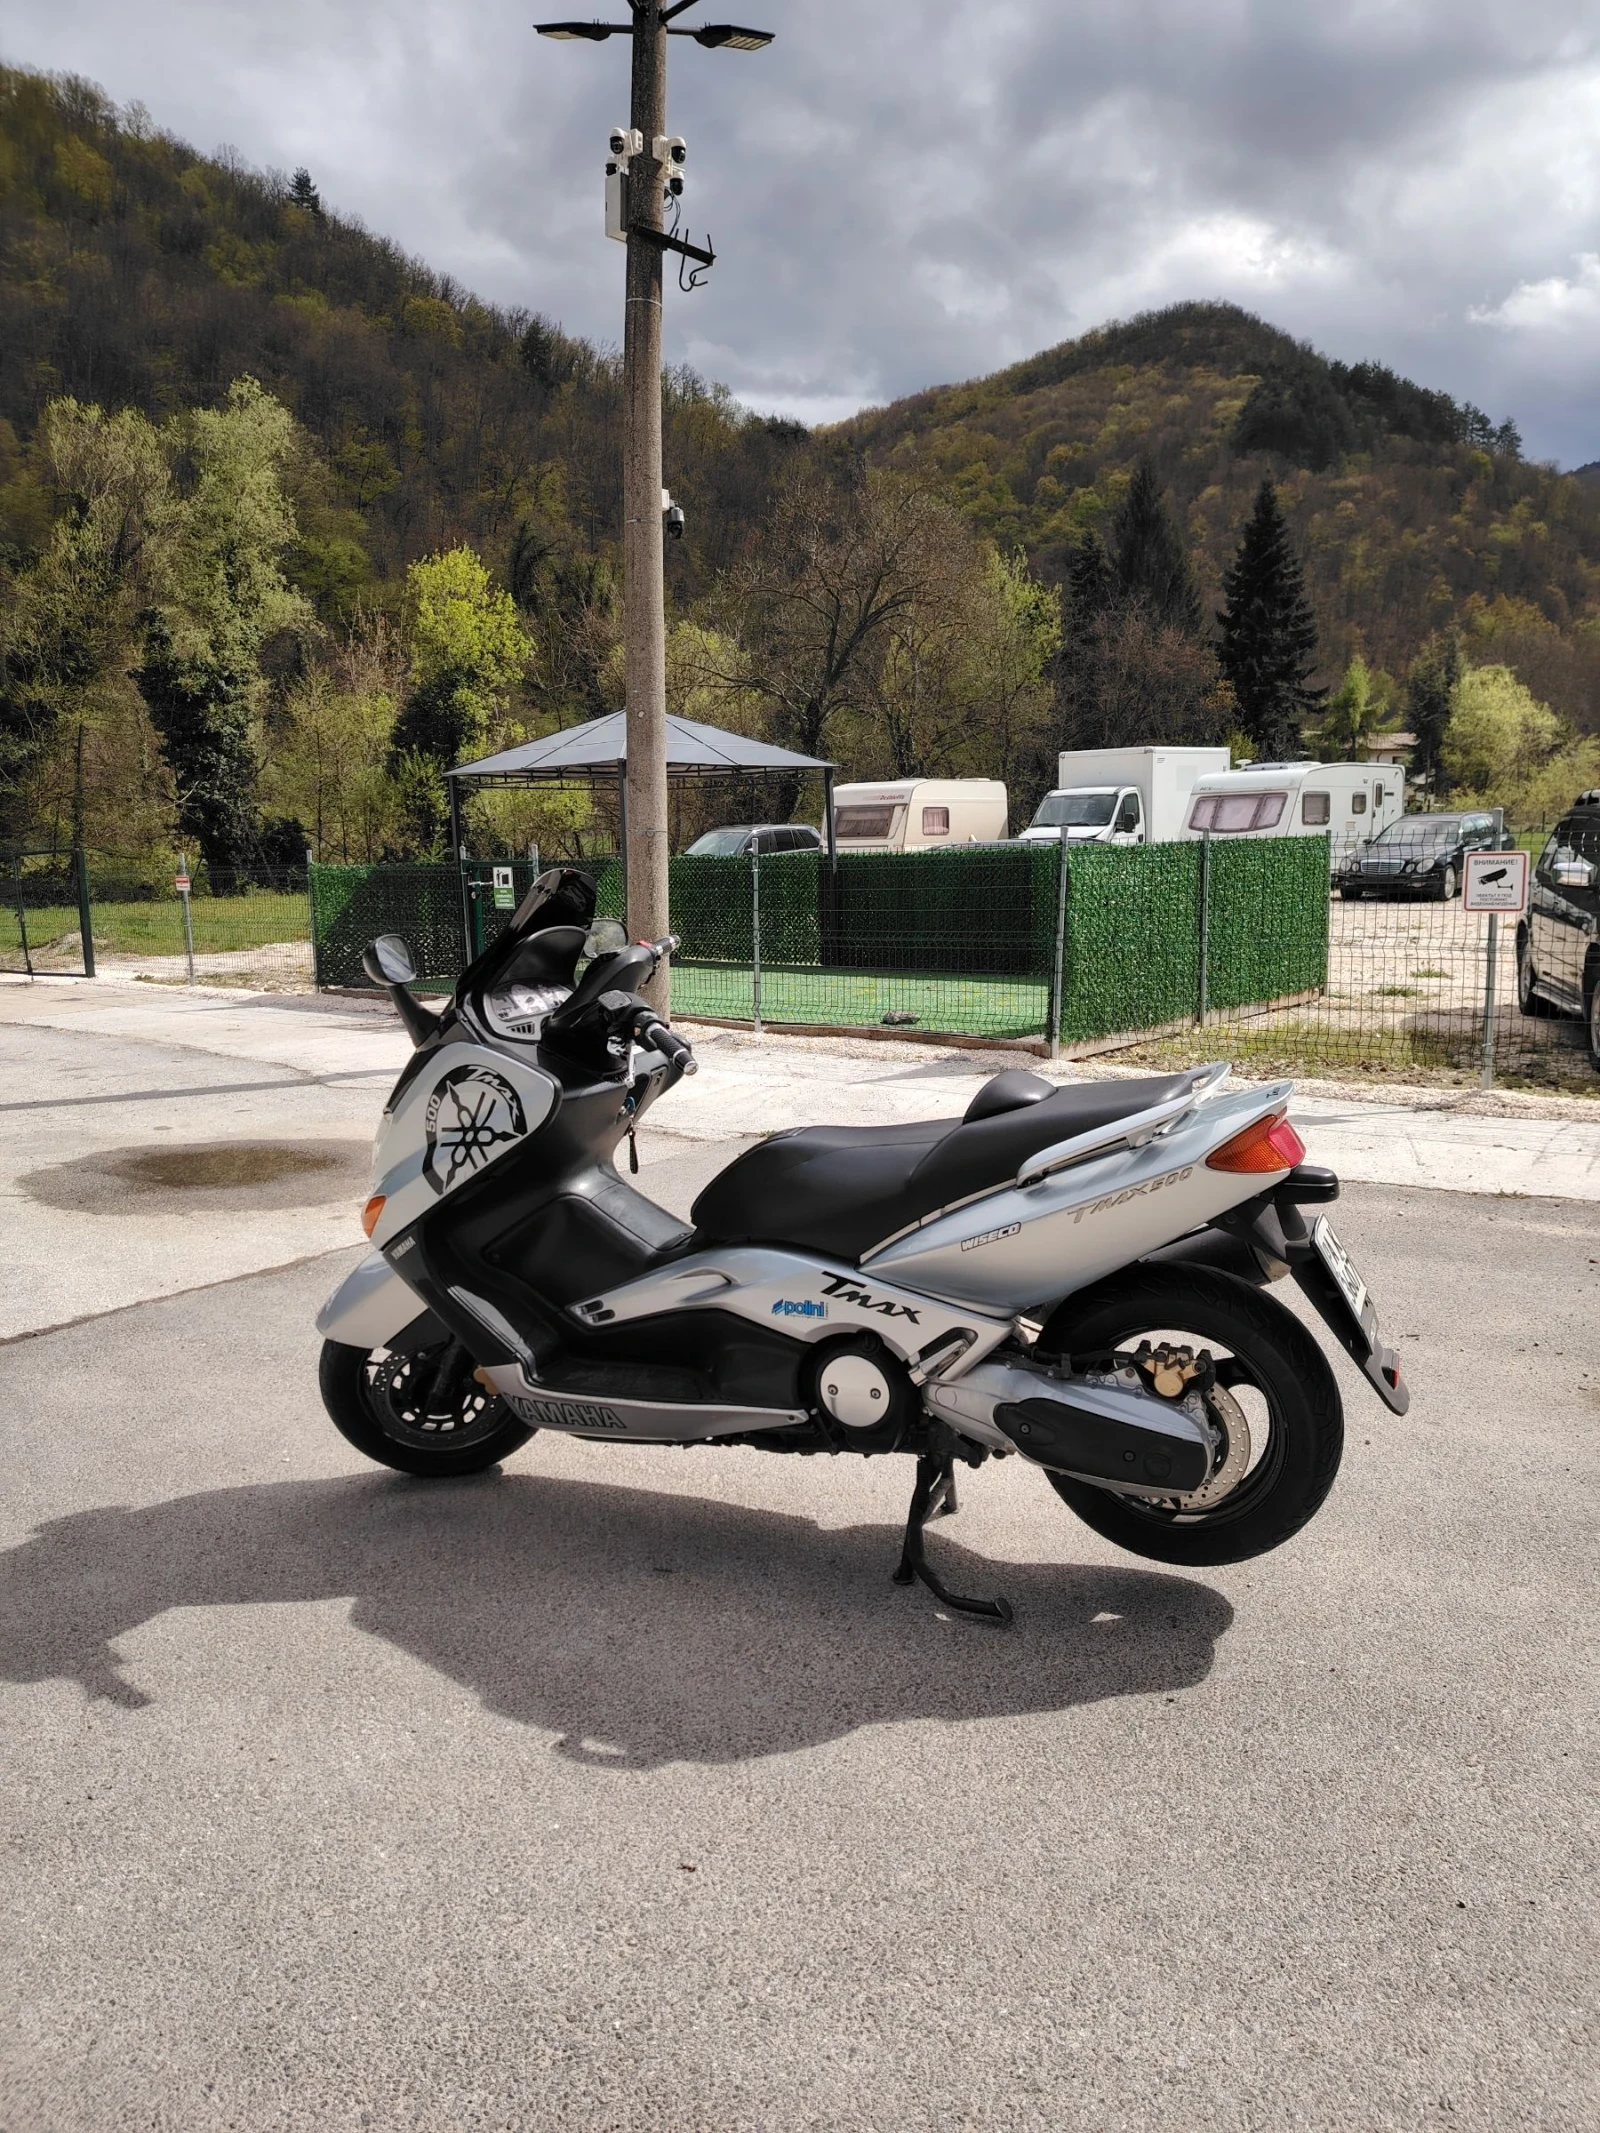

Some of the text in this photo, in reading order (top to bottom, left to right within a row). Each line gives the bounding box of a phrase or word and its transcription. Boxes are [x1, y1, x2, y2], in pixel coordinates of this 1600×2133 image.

[426, 1094, 441, 1133] 500
[961, 1222, 1021, 1251] WISECO
[784, 1299, 825, 1317] polini
[502, 1392, 627, 1429] YAMAHA
